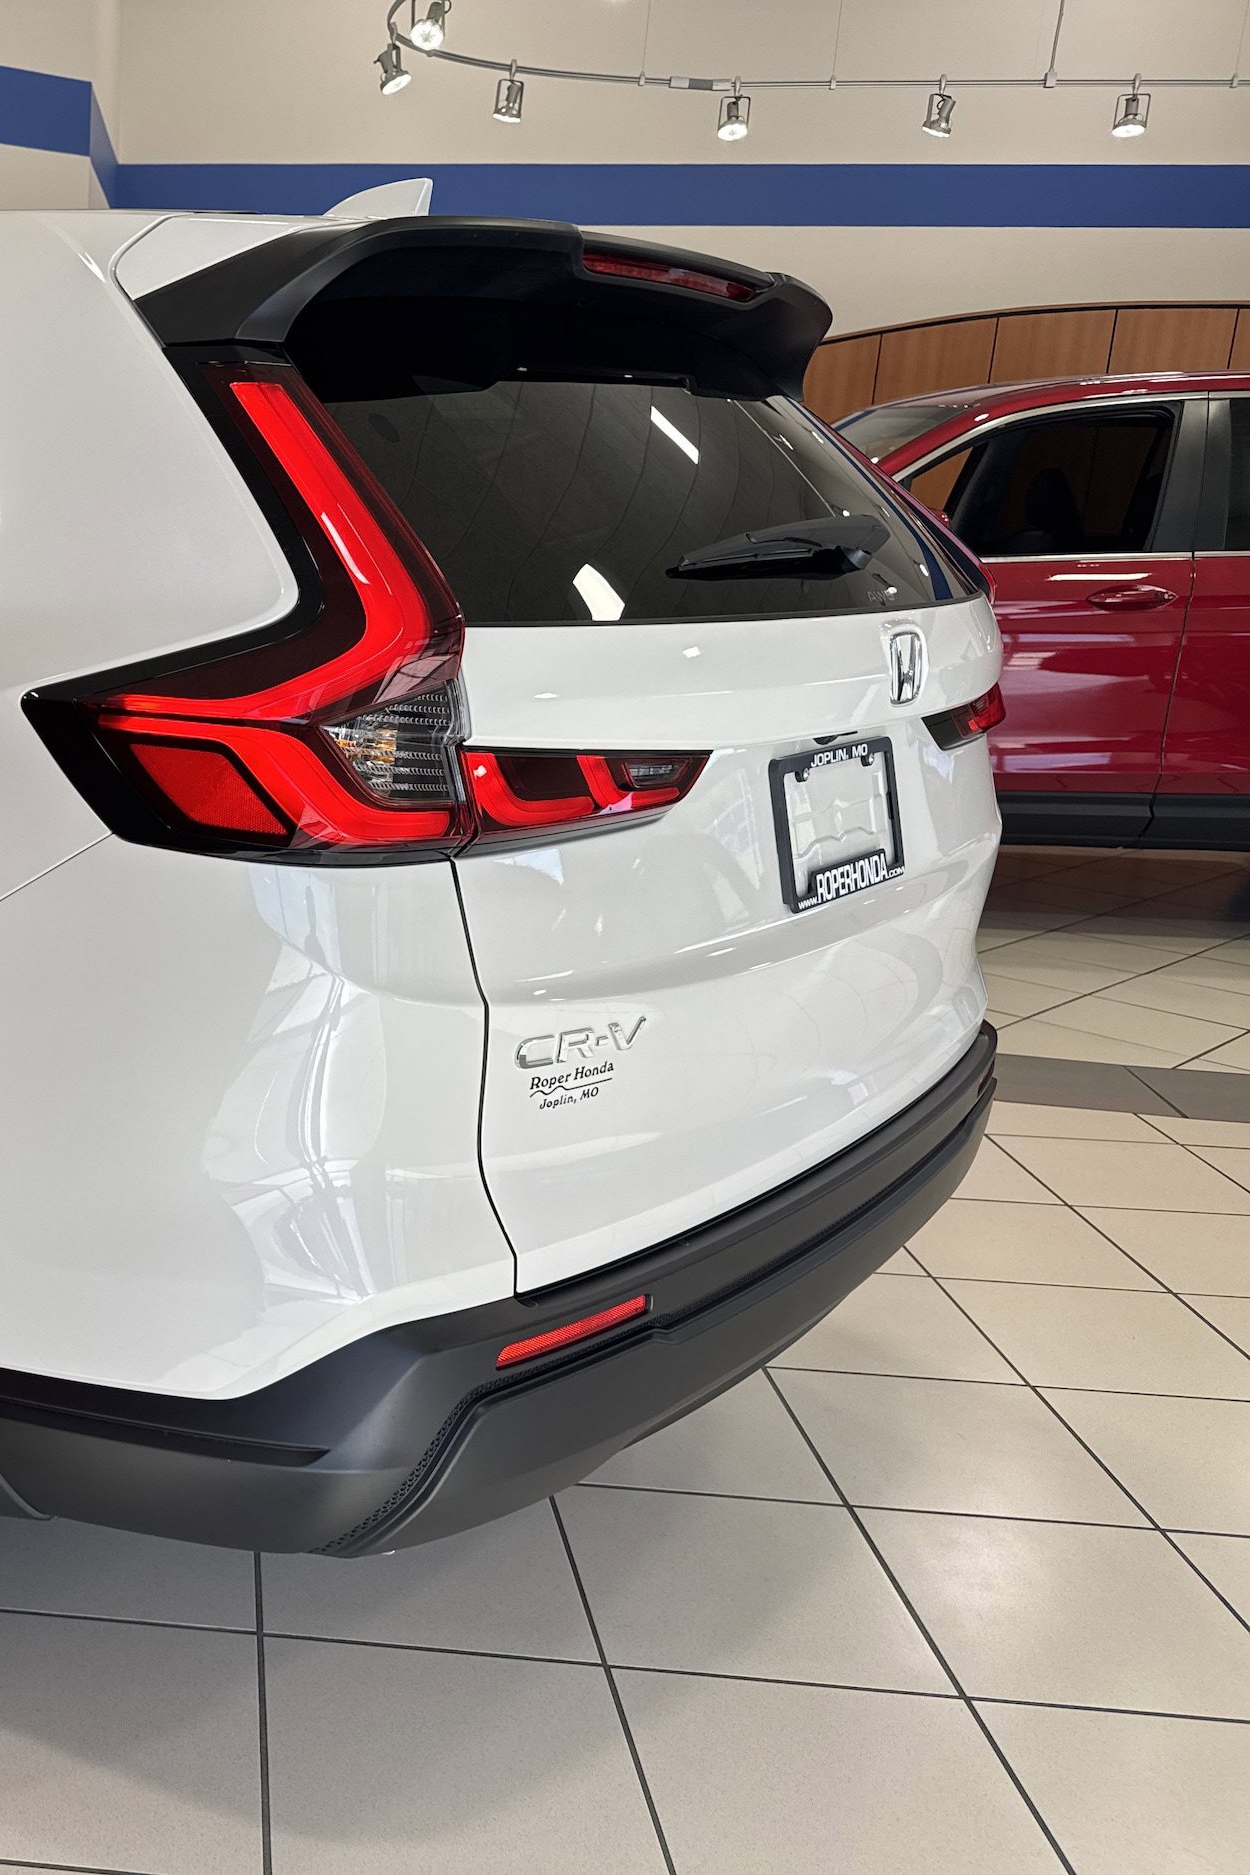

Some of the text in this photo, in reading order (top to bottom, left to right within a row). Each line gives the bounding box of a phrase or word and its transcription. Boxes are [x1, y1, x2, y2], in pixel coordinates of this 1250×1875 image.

[852, 743, 868, 757] MO
[514, 1015, 647, 1069] CR-V
[530, 1060, 615, 1090] Roper Honda
[539, 1086, 599, 1110] Joplin, MO
